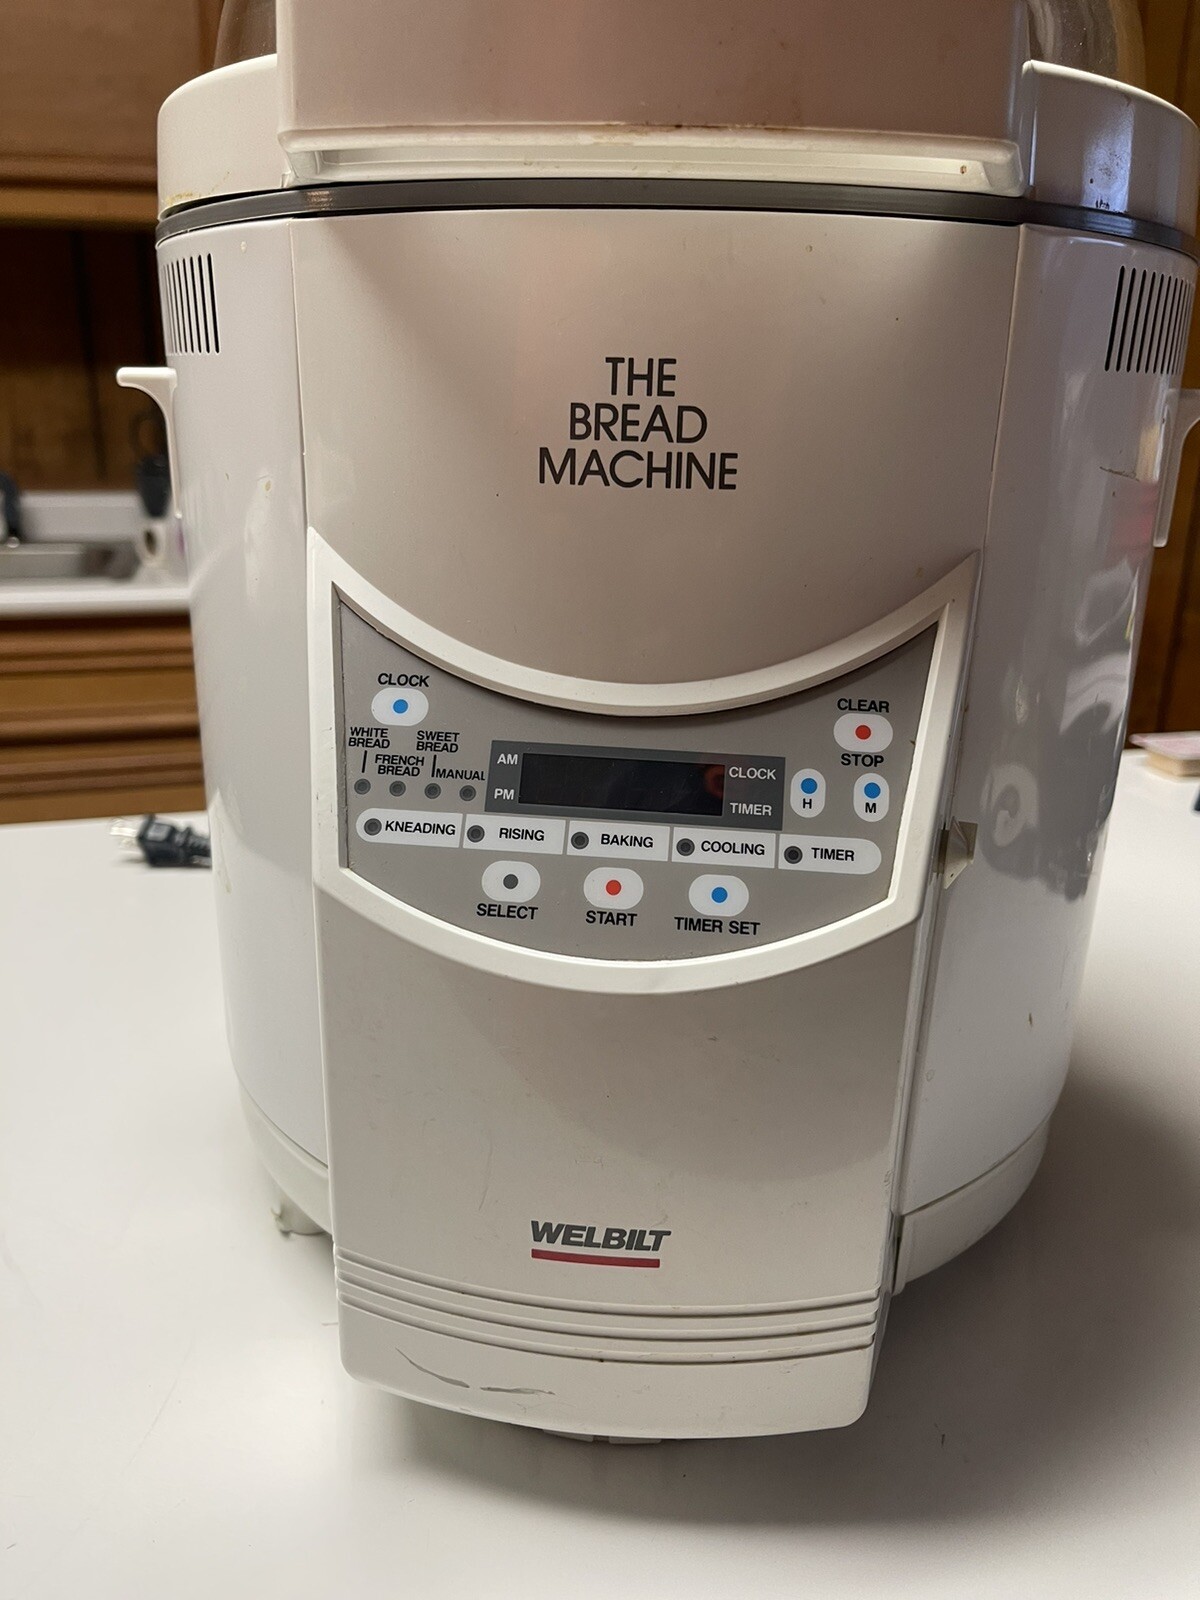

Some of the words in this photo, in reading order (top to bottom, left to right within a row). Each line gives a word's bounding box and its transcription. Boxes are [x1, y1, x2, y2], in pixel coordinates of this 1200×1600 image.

[605, 357, 677, 397] THE
[569, 402, 708, 443] BREAD
[539, 447, 738, 490] MACHINE
[377, 673, 430, 688] CLOCK
[837, 698, 890, 713] CLEAR
[349, 726, 389, 738] WHITE
[416, 730, 460, 742] SWEET
[348, 737, 391, 749] BREAD
[416, 741, 459, 753] BREAD
[374, 754, 425, 766] FRENCH
[497, 754, 518, 765] AM
[840, 753, 885, 768] STOP
[377, 764, 421, 777] BREAD
[435, 768, 486, 781] MANUAL
[728, 766, 777, 780] CLOCK
[494, 788, 515, 800] PM
[730, 802, 772, 816] TIMER
[802, 798, 813, 809] H
[864, 802, 877, 813] M
[385, 820, 456, 835] KNEADING
[499, 828, 545, 842] RISING
[600, 833, 654, 848] BAKING
[700, 840, 766, 856] COOLING
[811, 847, 855, 861] TIMER
[476, 903, 539, 920] SELECT
[585, 910, 638, 926] START
[674, 916, 723, 933] TIMER
[728, 920, 760, 935] SET
[531, 1220, 672, 1251] WELBILT
